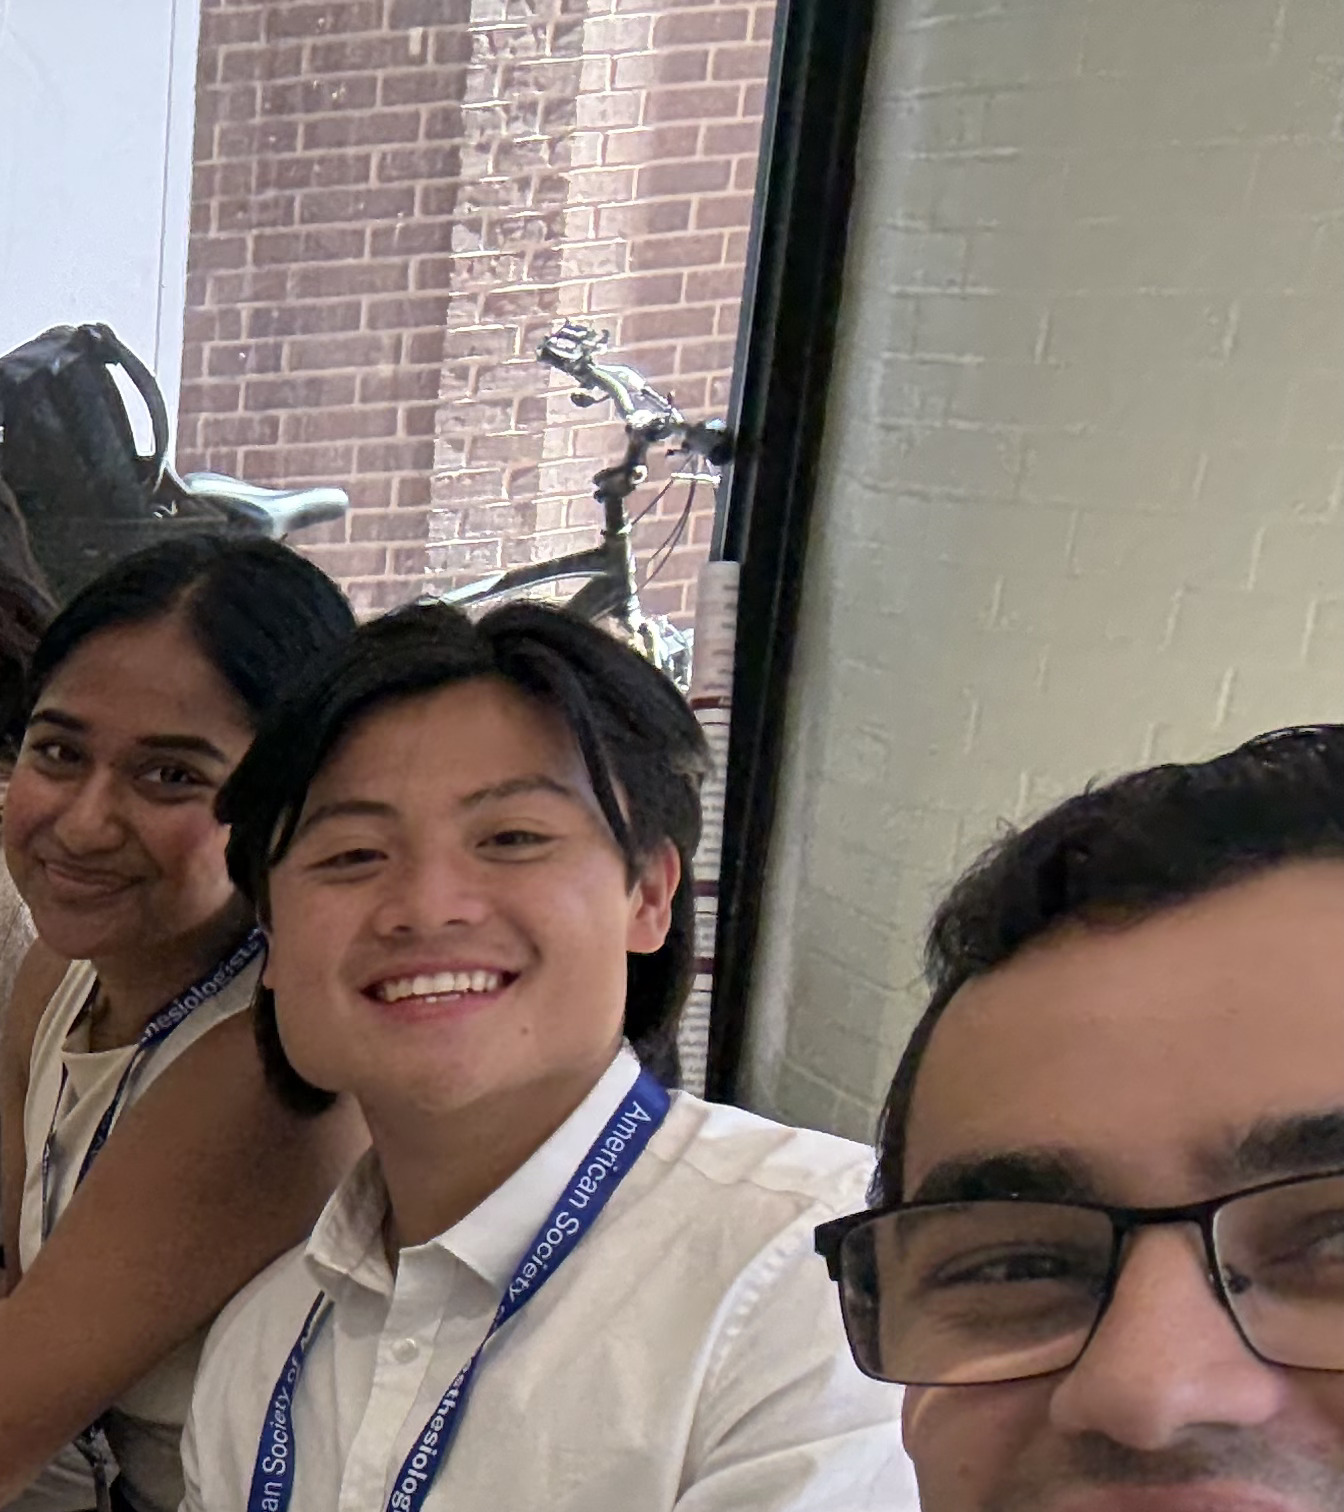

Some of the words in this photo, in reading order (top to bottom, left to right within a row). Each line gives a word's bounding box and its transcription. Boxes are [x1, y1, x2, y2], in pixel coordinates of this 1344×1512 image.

[570, 1099, 653, 1211] American
[509, 1200, 582, 1300] Society
[263, 1389, 293, 1477] Society
